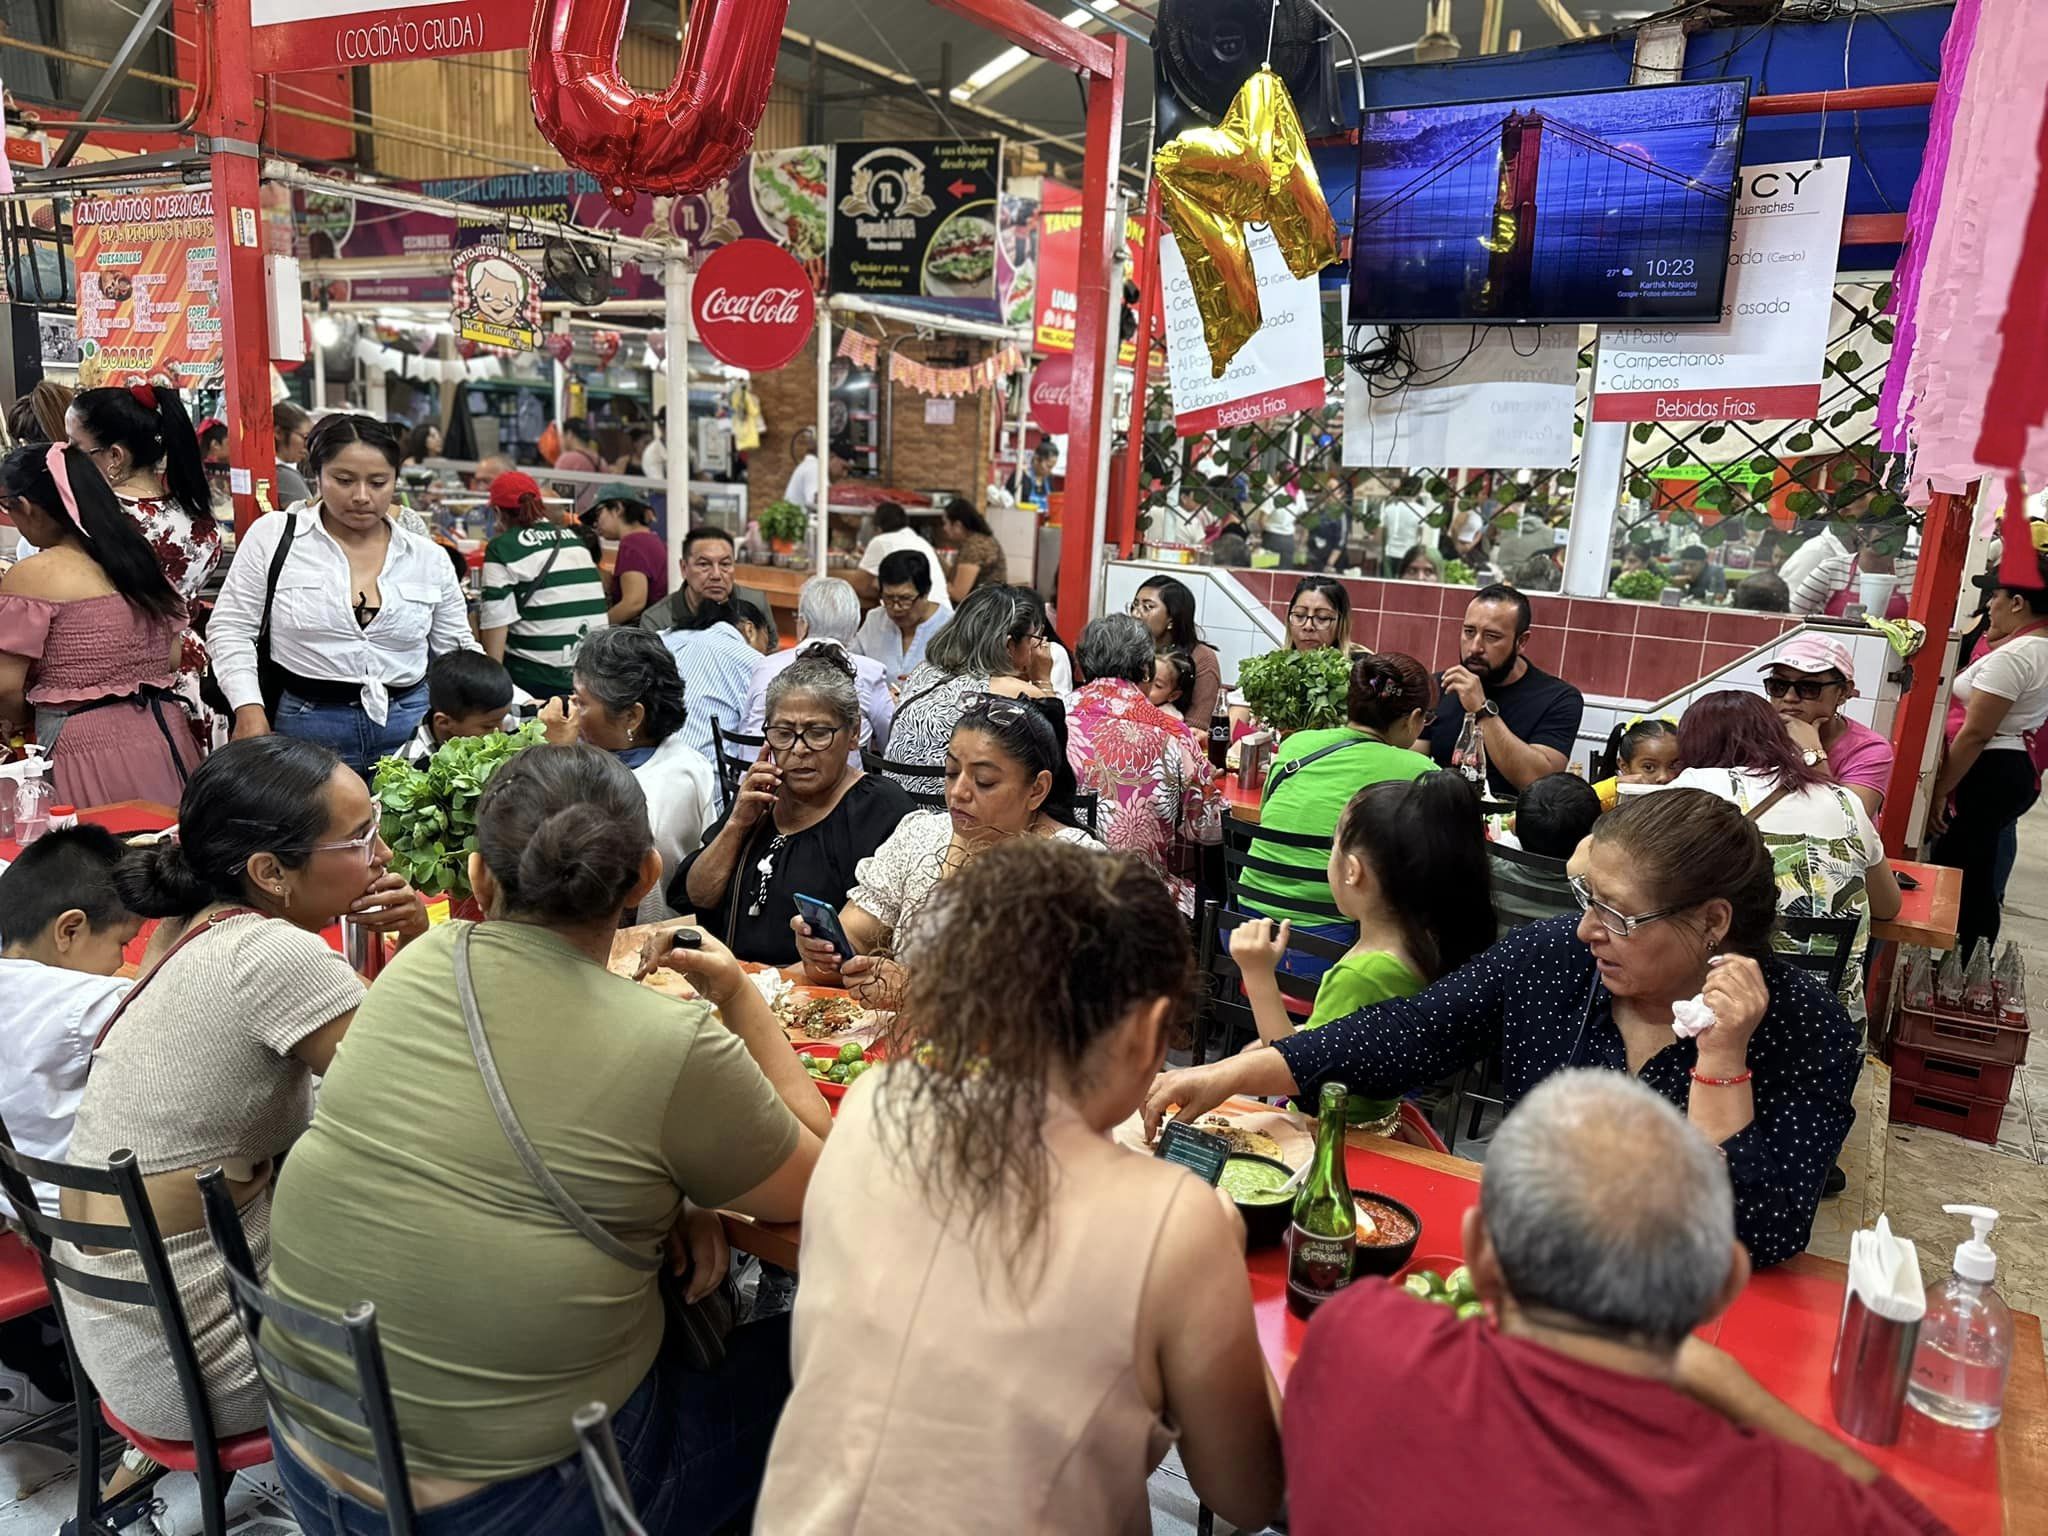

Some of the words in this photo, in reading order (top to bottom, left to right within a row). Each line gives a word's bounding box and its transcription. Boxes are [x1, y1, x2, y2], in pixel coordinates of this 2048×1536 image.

[404, 22, 419, 53] O
[482, 176, 526, 200] LUPITA
[527, 173, 570, 197] DESDE
[77, 197, 151, 225] ANTOJITOS
[1733, 202, 1795, 216] Huaraches
[98, 251, 142, 265] QUESADILLAS
[1767, 250, 1806, 263] (Cerdo)
[453, 245, 500, 268] ANTOJITOS
[500, 249, 547, 290] MEXICANOS
[1646, 259, 1695, 277] 10:23
[1639, 280, 1667, 290] Karthik
[1667, 280, 1698, 290] Nagaraj
[1617, 290, 1638, 299] Google
[188, 306, 209, 318] SOPES
[1737, 297, 1790, 315] asada
[1614, 328, 1629, 344] Al
[1632, 328, 1678, 344] Pastor
[100, 347, 154, 371] BOMBAS
[1613, 352, 1725, 370] Campechanos
[1610, 375, 1680, 391] Cubanos
[1181, 389, 1229, 410] Cubanos
[1656, 397, 1718, 418] Bebidas
[1722, 396, 1756, 416] Frías
[1217, 402, 1261, 426] Bebidas
